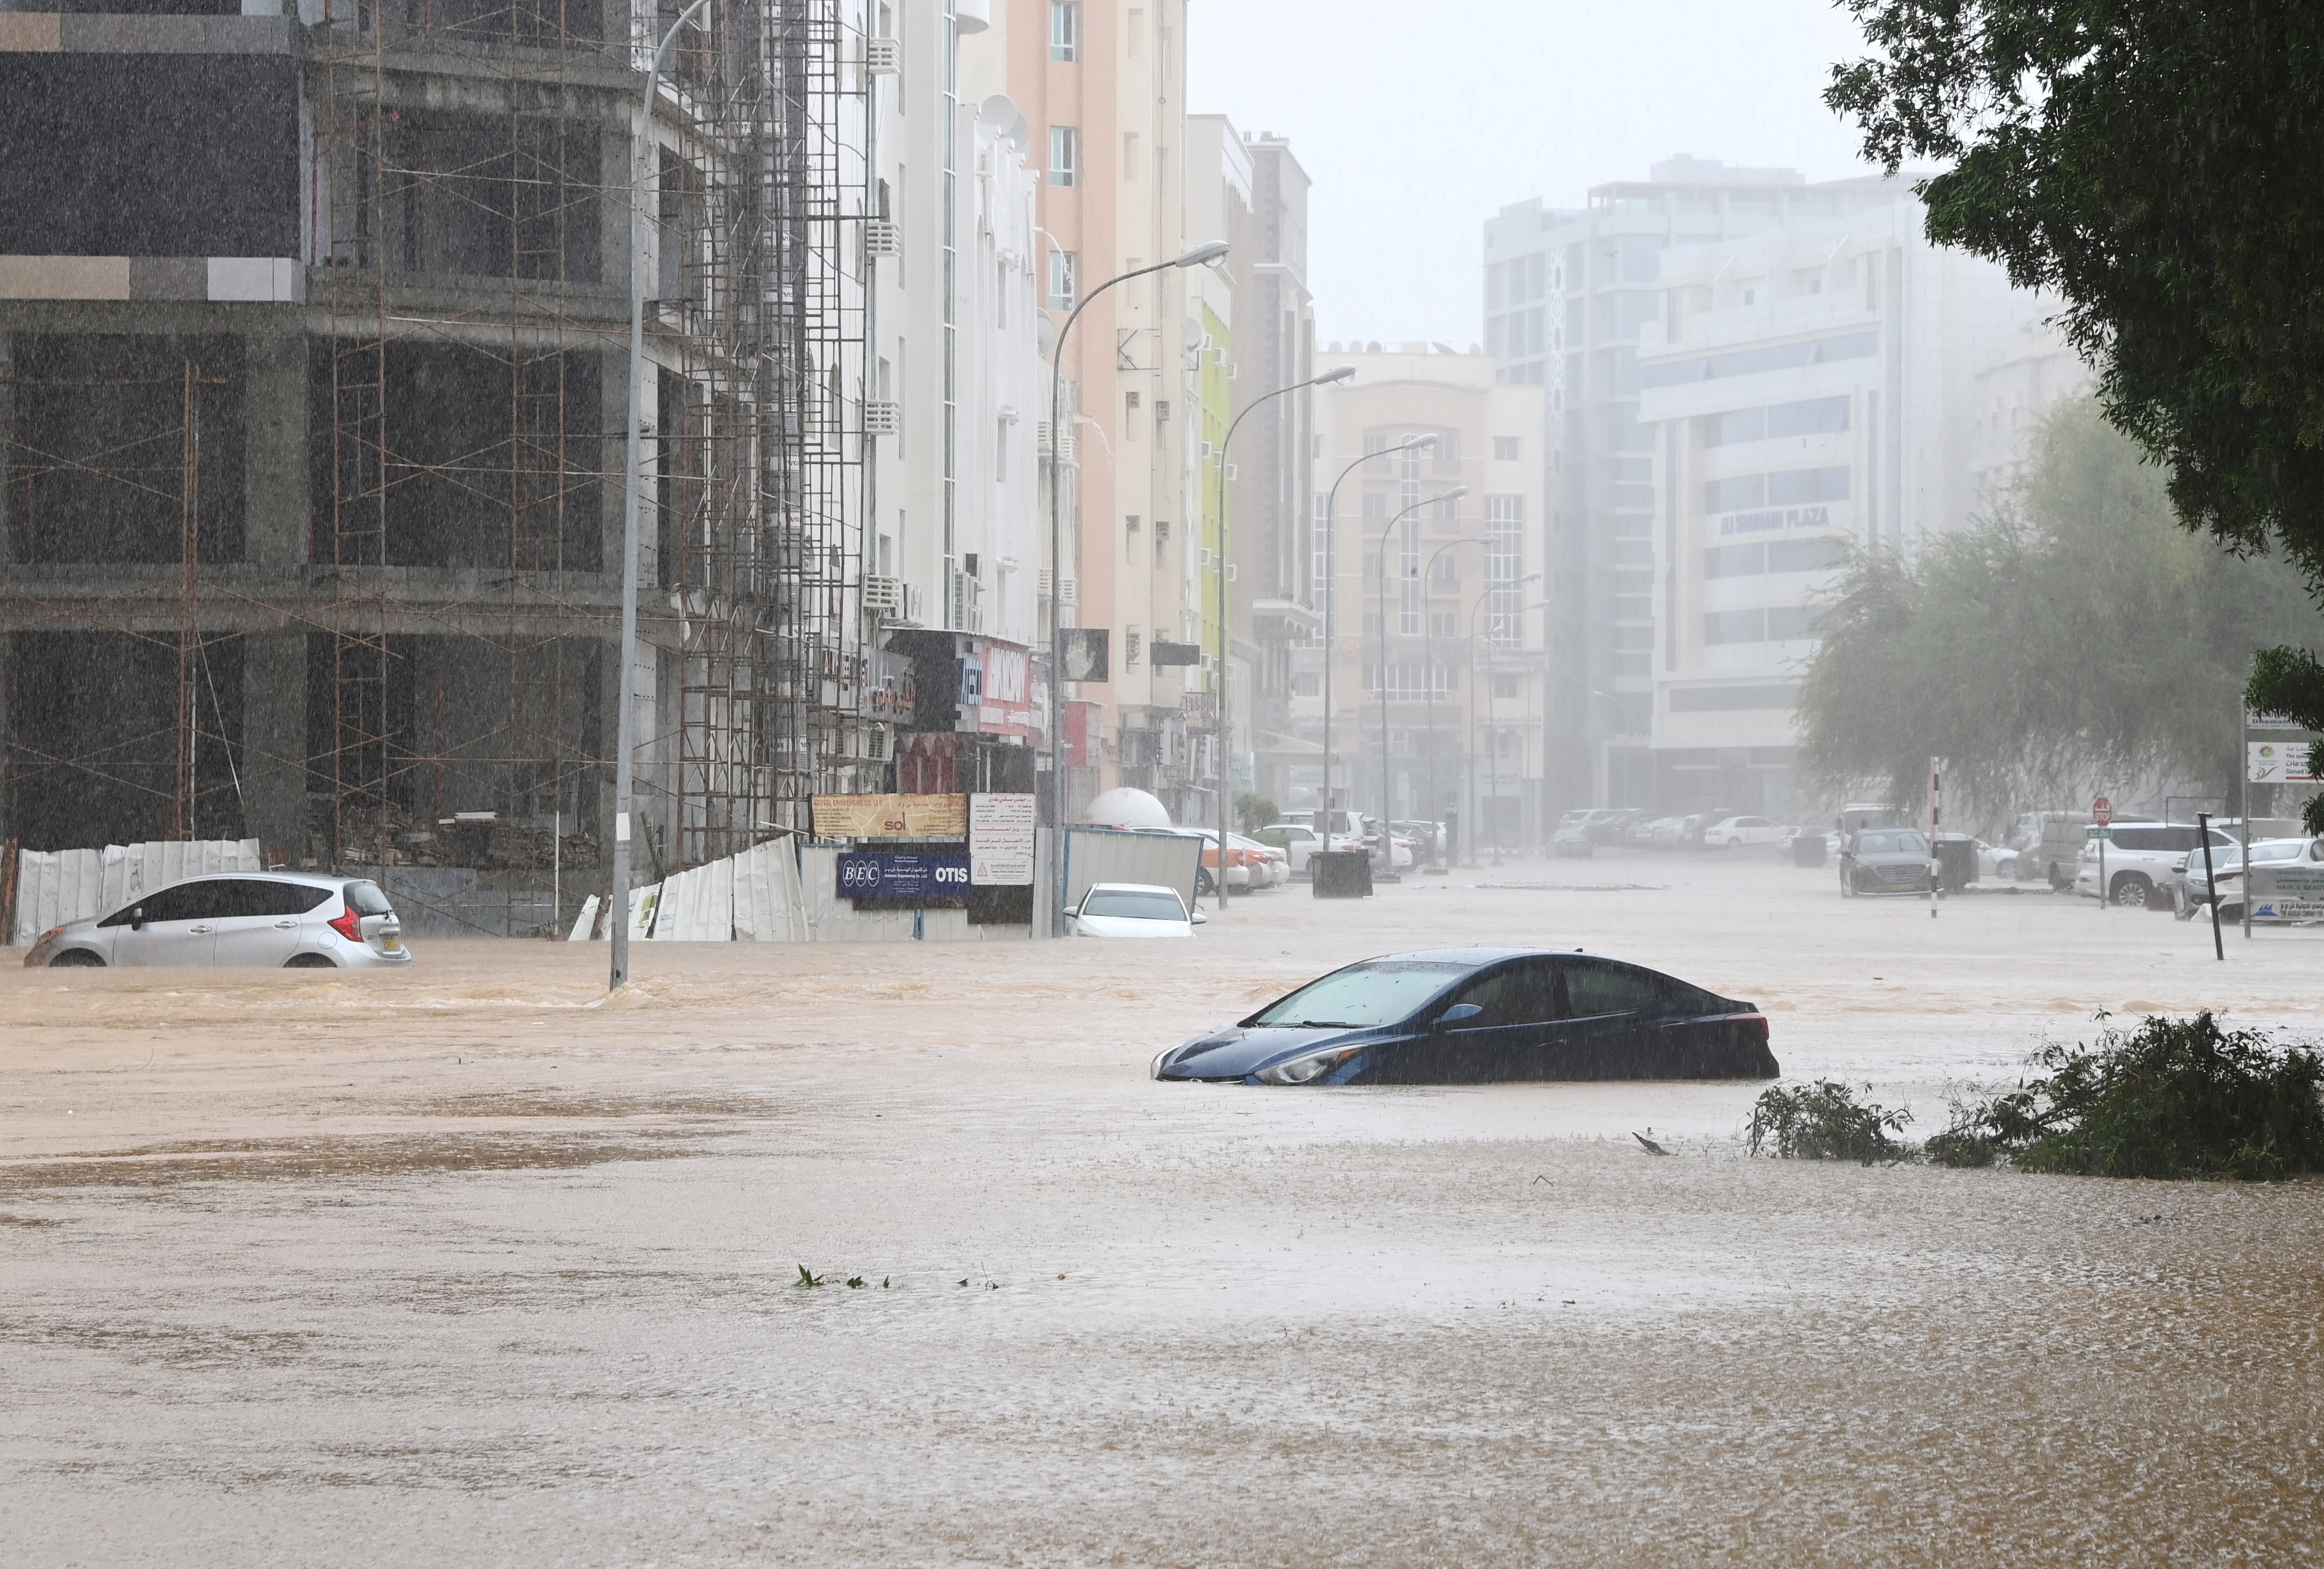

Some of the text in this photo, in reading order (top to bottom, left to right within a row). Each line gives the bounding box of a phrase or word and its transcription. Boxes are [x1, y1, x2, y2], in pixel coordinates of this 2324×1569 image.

[1787, 507, 1829, 528] PLAZA
[884, 811, 906, 830] sol
[936, 867, 968, 883] OTIS
